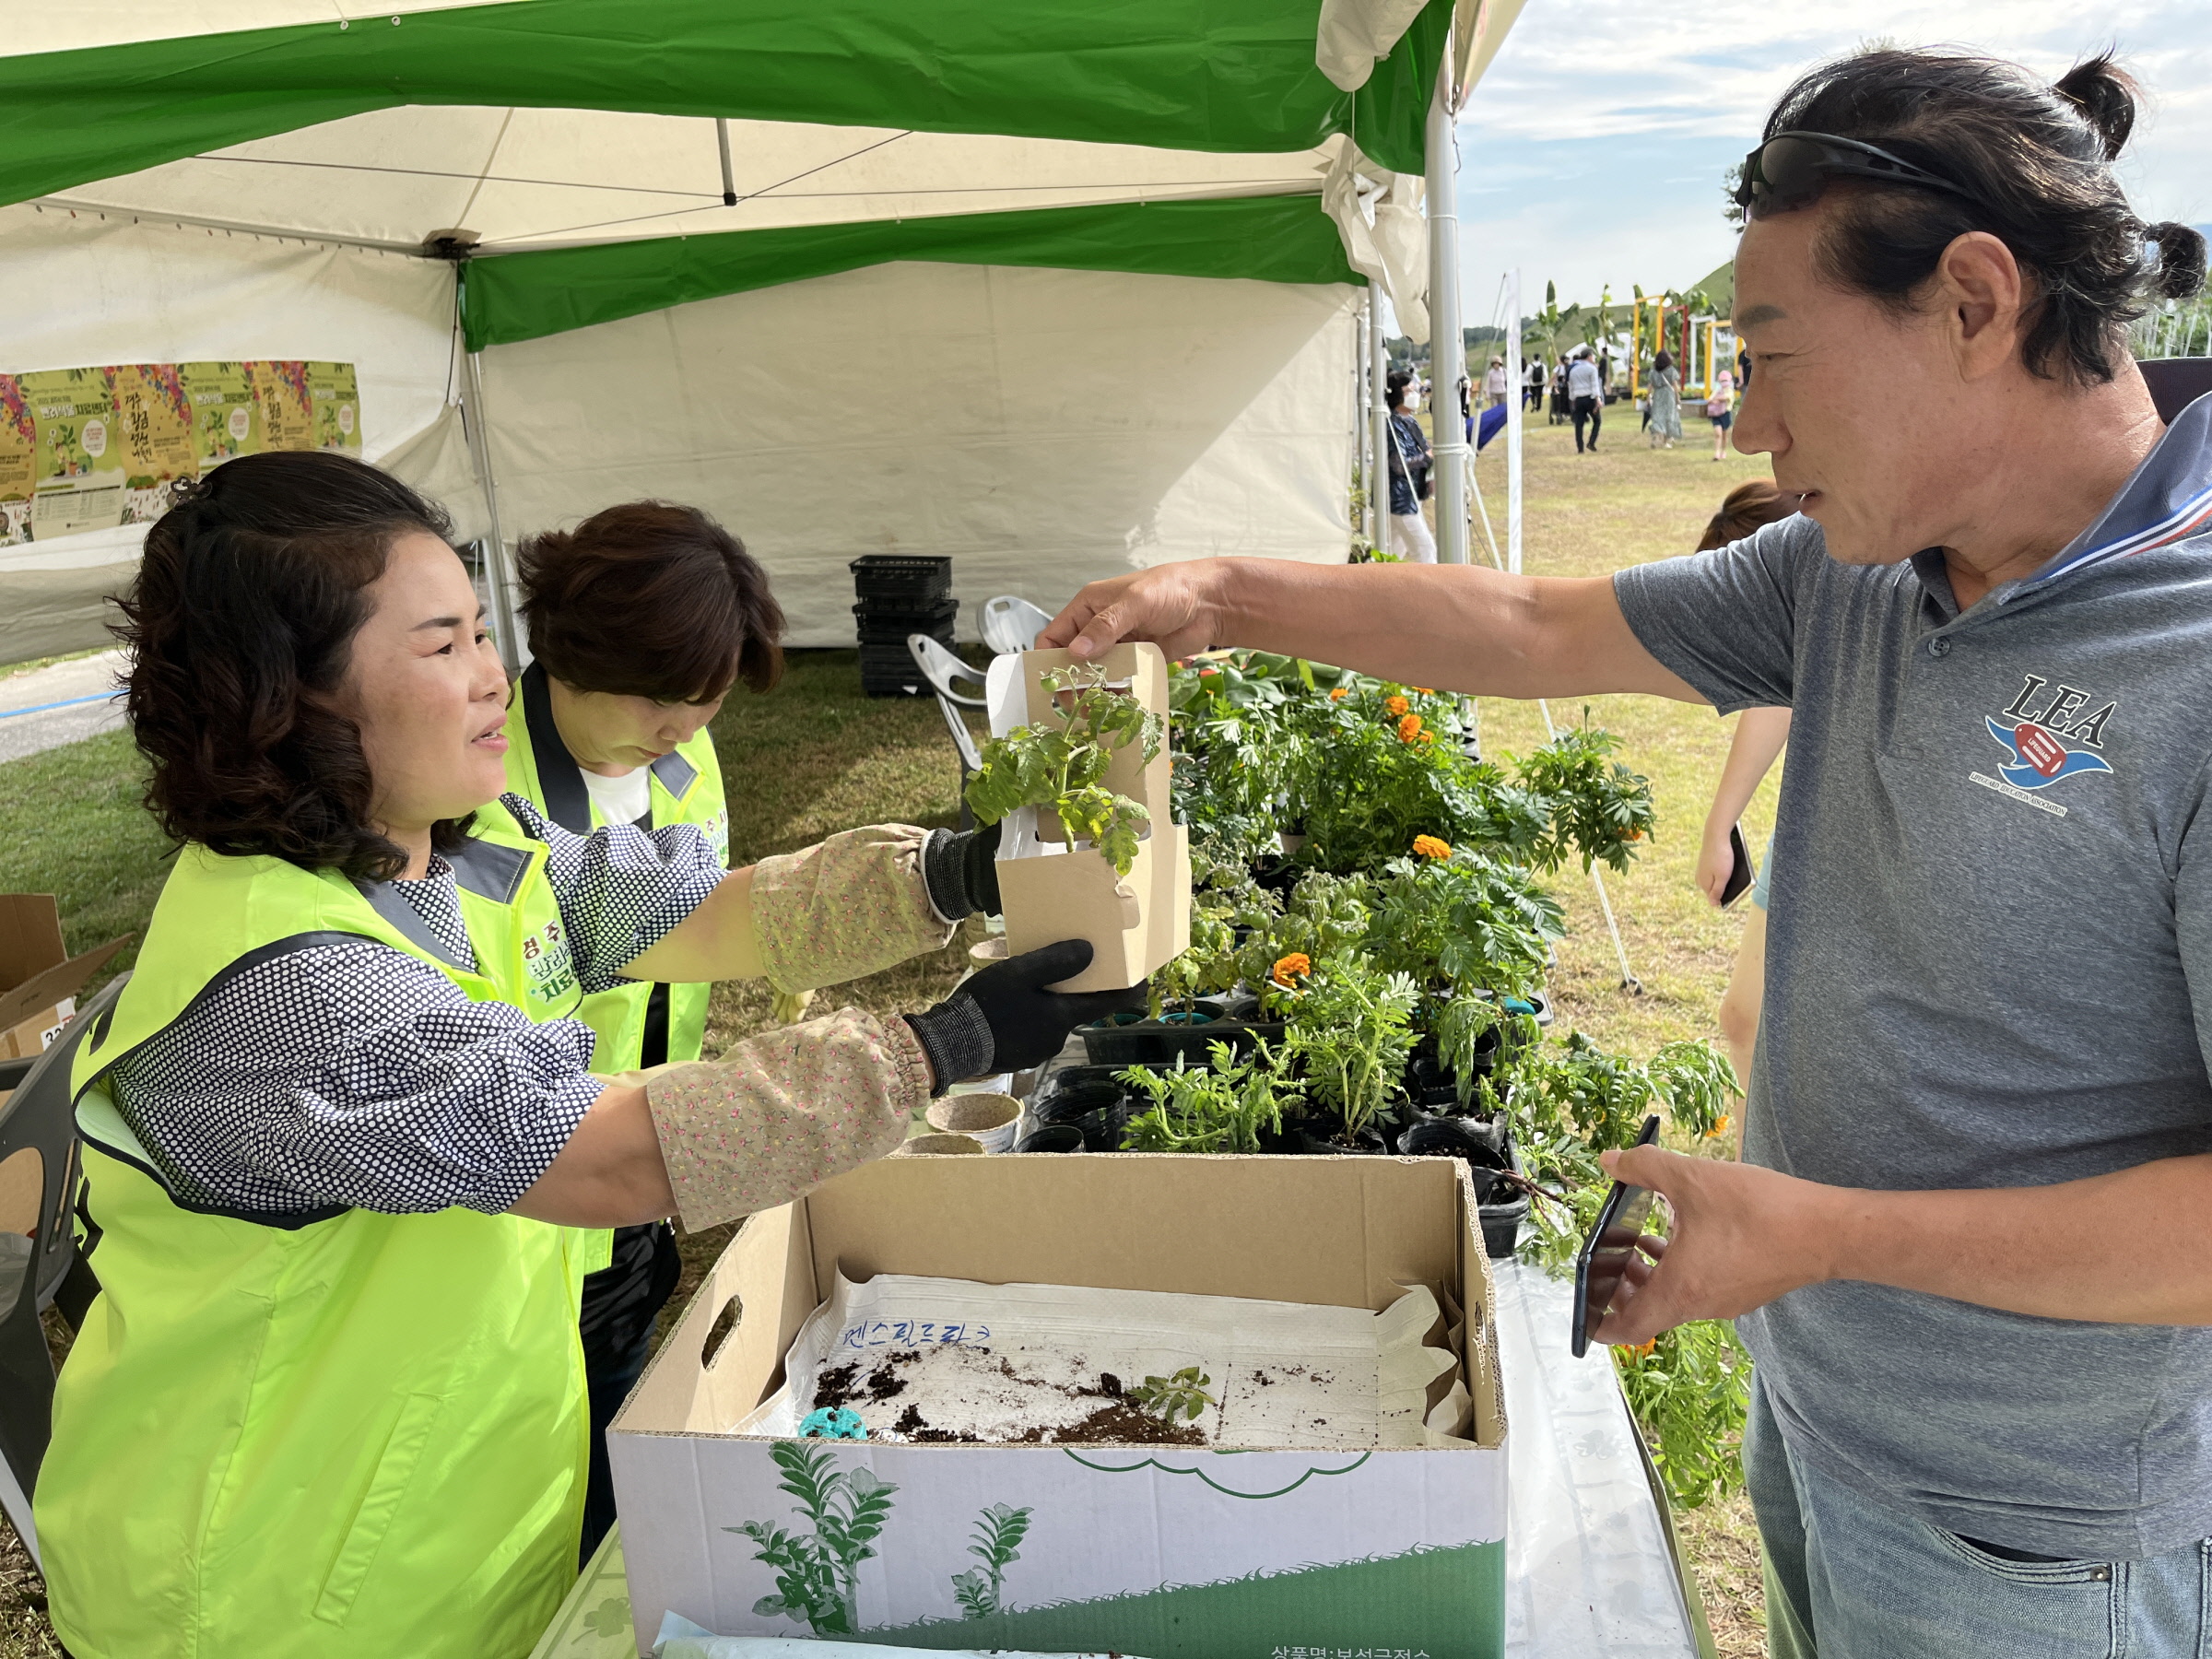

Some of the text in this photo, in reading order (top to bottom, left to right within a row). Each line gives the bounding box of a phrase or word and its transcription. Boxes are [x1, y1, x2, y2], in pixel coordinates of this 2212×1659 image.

[2002, 674, 2117, 749] LEA
[2028, 737, 2051, 763] LIFEGUARD
[1970, 772, 2066, 816] LIFEGUARD EDUCATION ASSOCIATION
